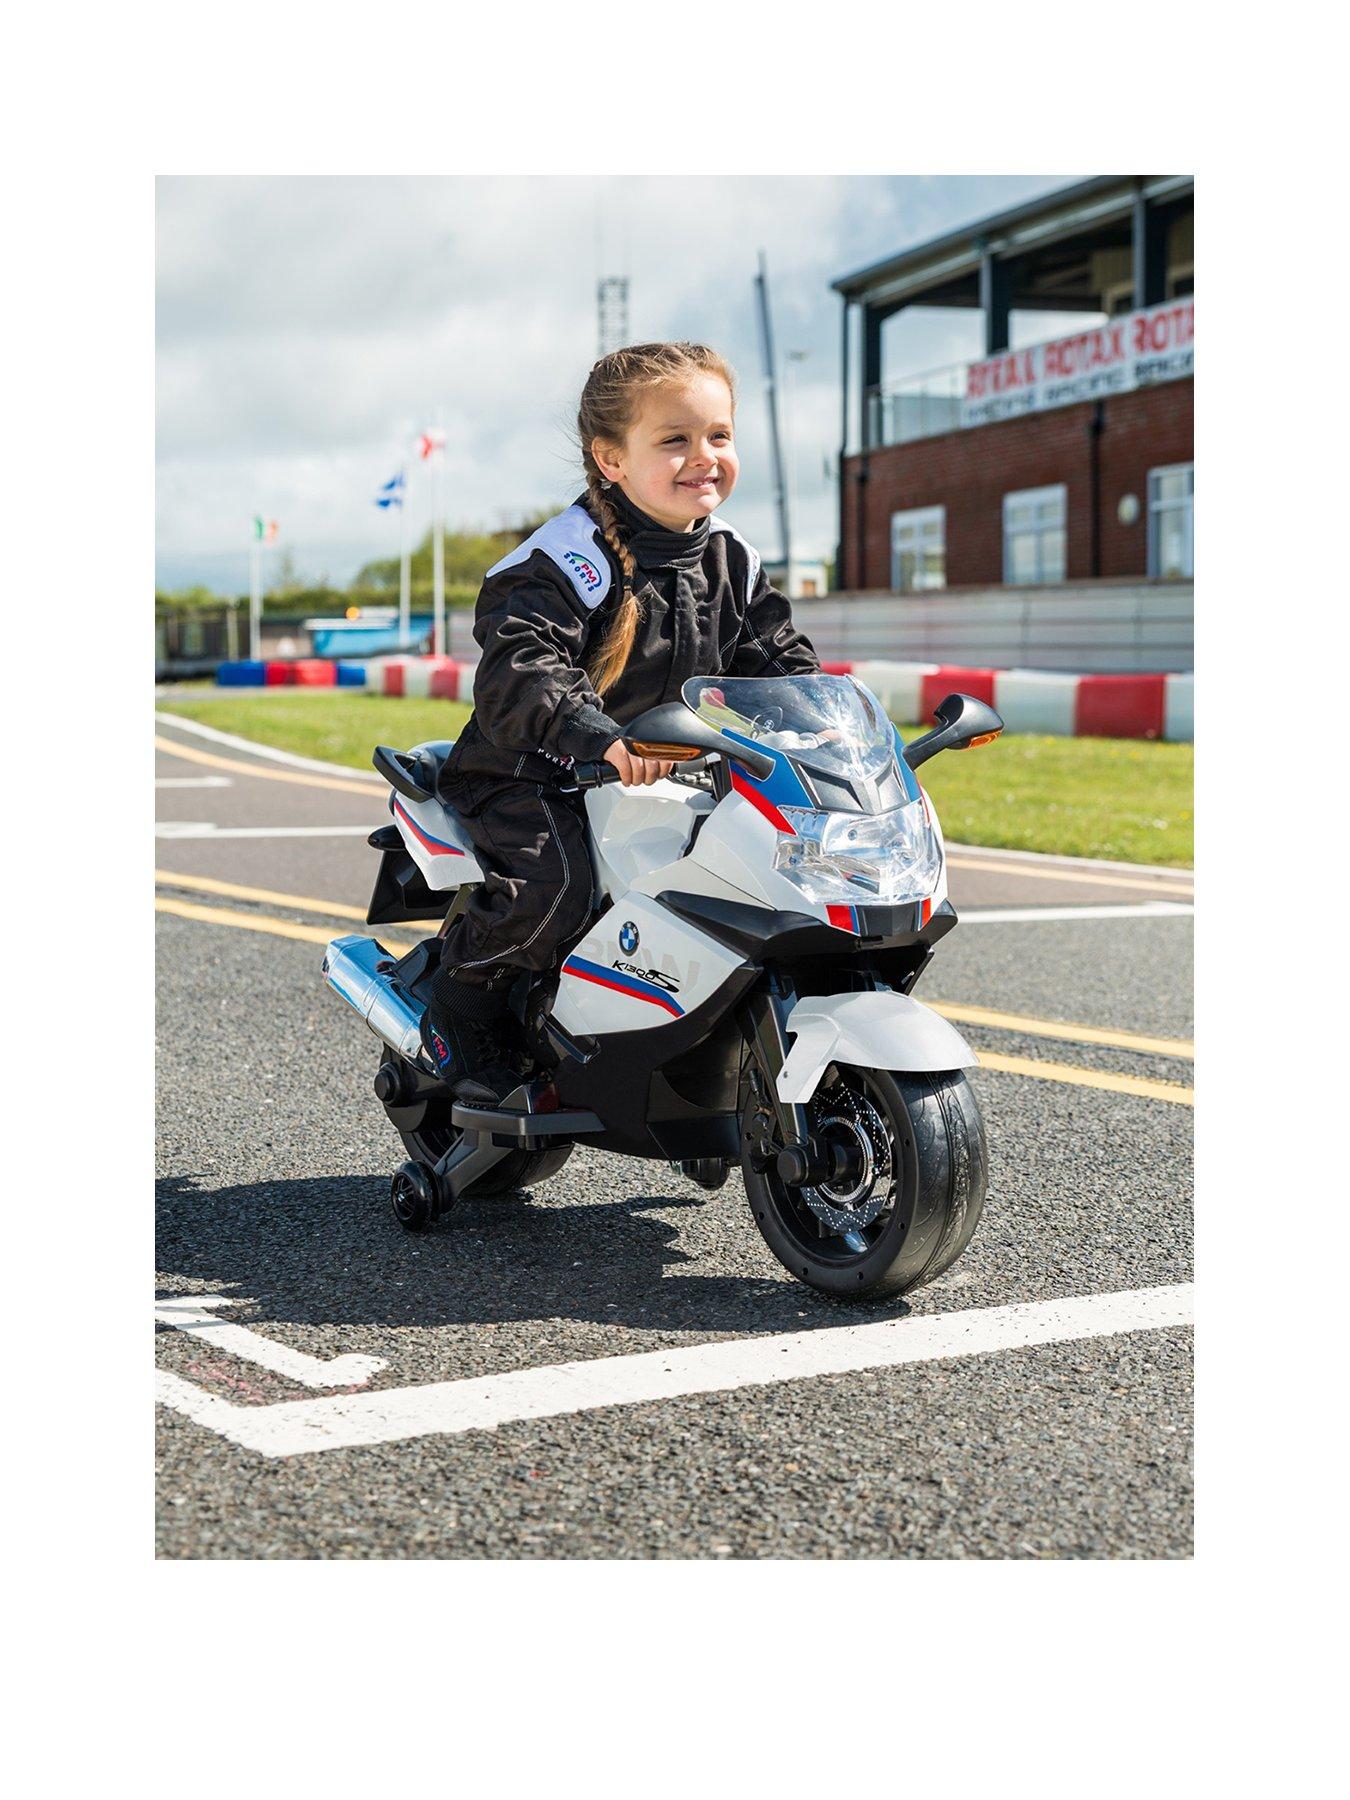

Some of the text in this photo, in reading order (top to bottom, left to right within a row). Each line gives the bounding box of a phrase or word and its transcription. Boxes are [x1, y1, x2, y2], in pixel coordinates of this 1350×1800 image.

[1133, 303, 1194, 354] ROTA
[563, 552, 595, 592] SPORTS
[581, 563, 597, 583] PM
